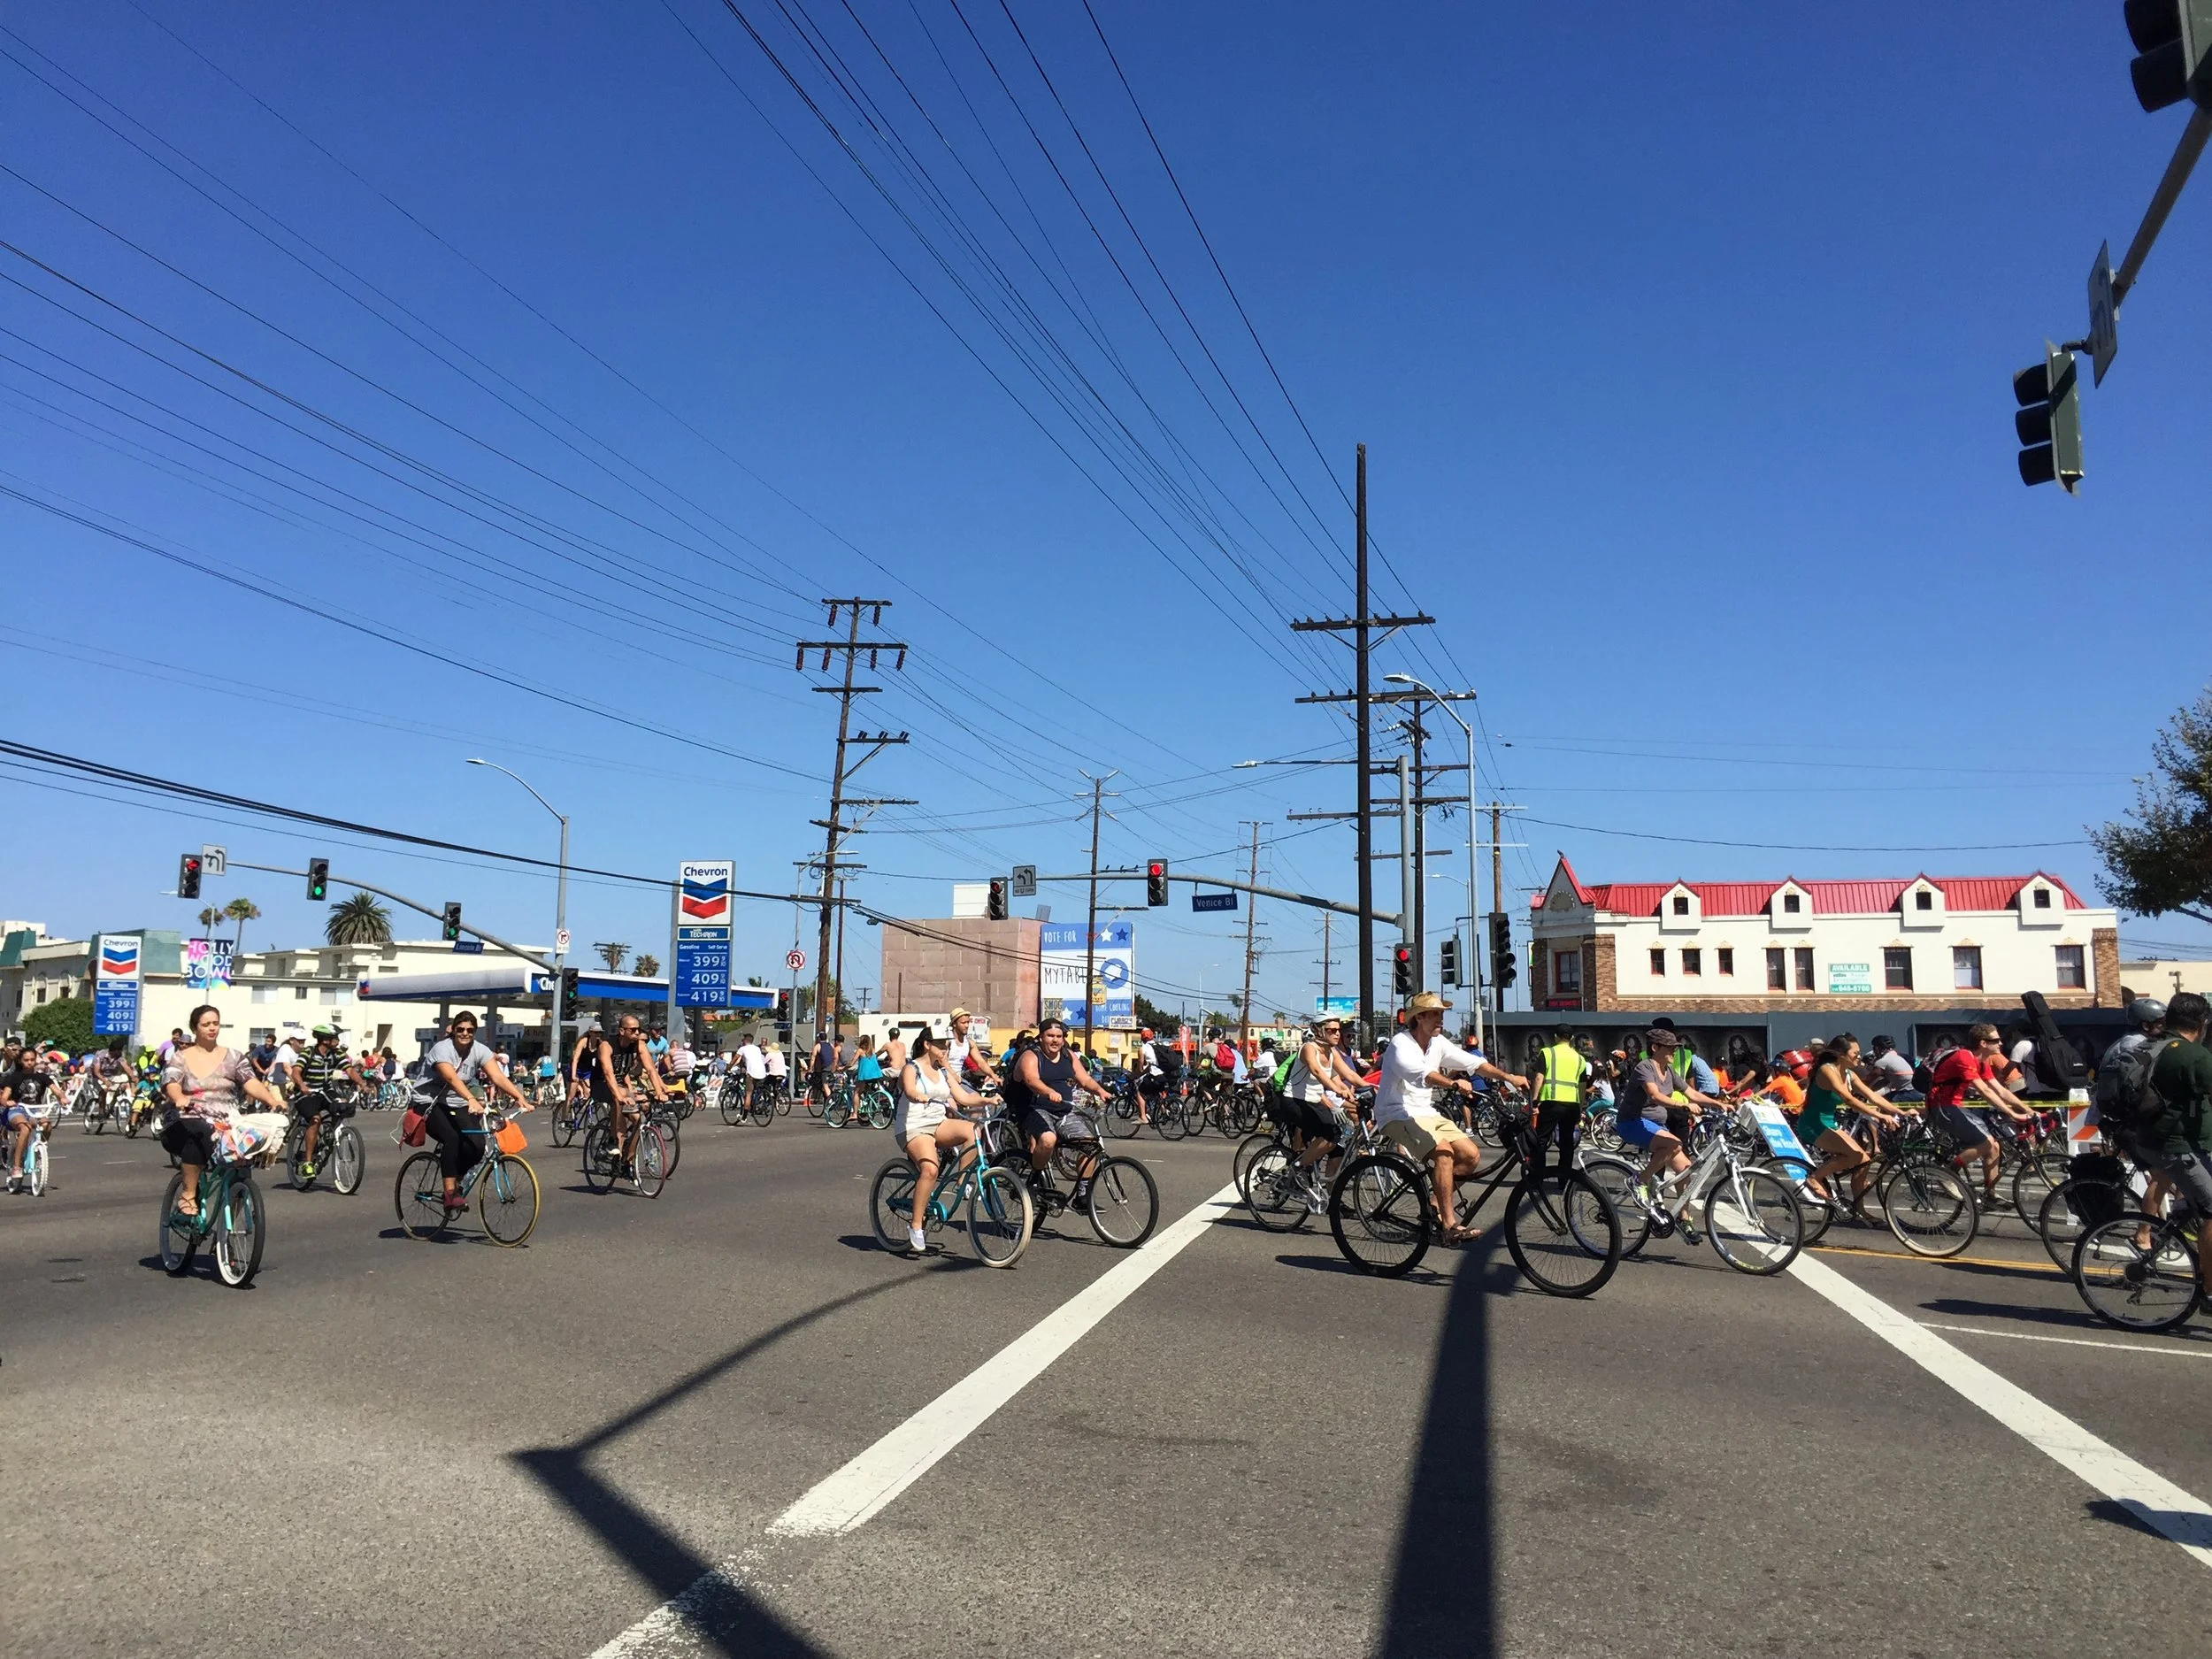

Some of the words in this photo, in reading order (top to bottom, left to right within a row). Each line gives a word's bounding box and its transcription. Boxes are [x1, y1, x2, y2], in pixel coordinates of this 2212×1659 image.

[683, 866, 728, 877] Chevron
[1196, 899, 1222, 908] Venice
[1225, 897, 1233, 906] Bl
[1044, 932, 1060, 943] VOTE
[1064, 930, 1077, 942] FOR
[188, 941, 234, 955] HOLLY
[694, 956, 720, 967] 399
[187, 965, 234, 979] BOWL
[1044, 965, 1087, 984] MYTABL
[691, 973, 719, 985] 409
[690, 991, 718, 1002] 419
[108, 1000, 130, 1009] 399
[1044, 1000, 1062, 1010] SMOG
[1109, 1002, 1130, 1011] COOKING
[106, 1011, 129, 1020] 409
[106, 1023, 129, 1032] 419
